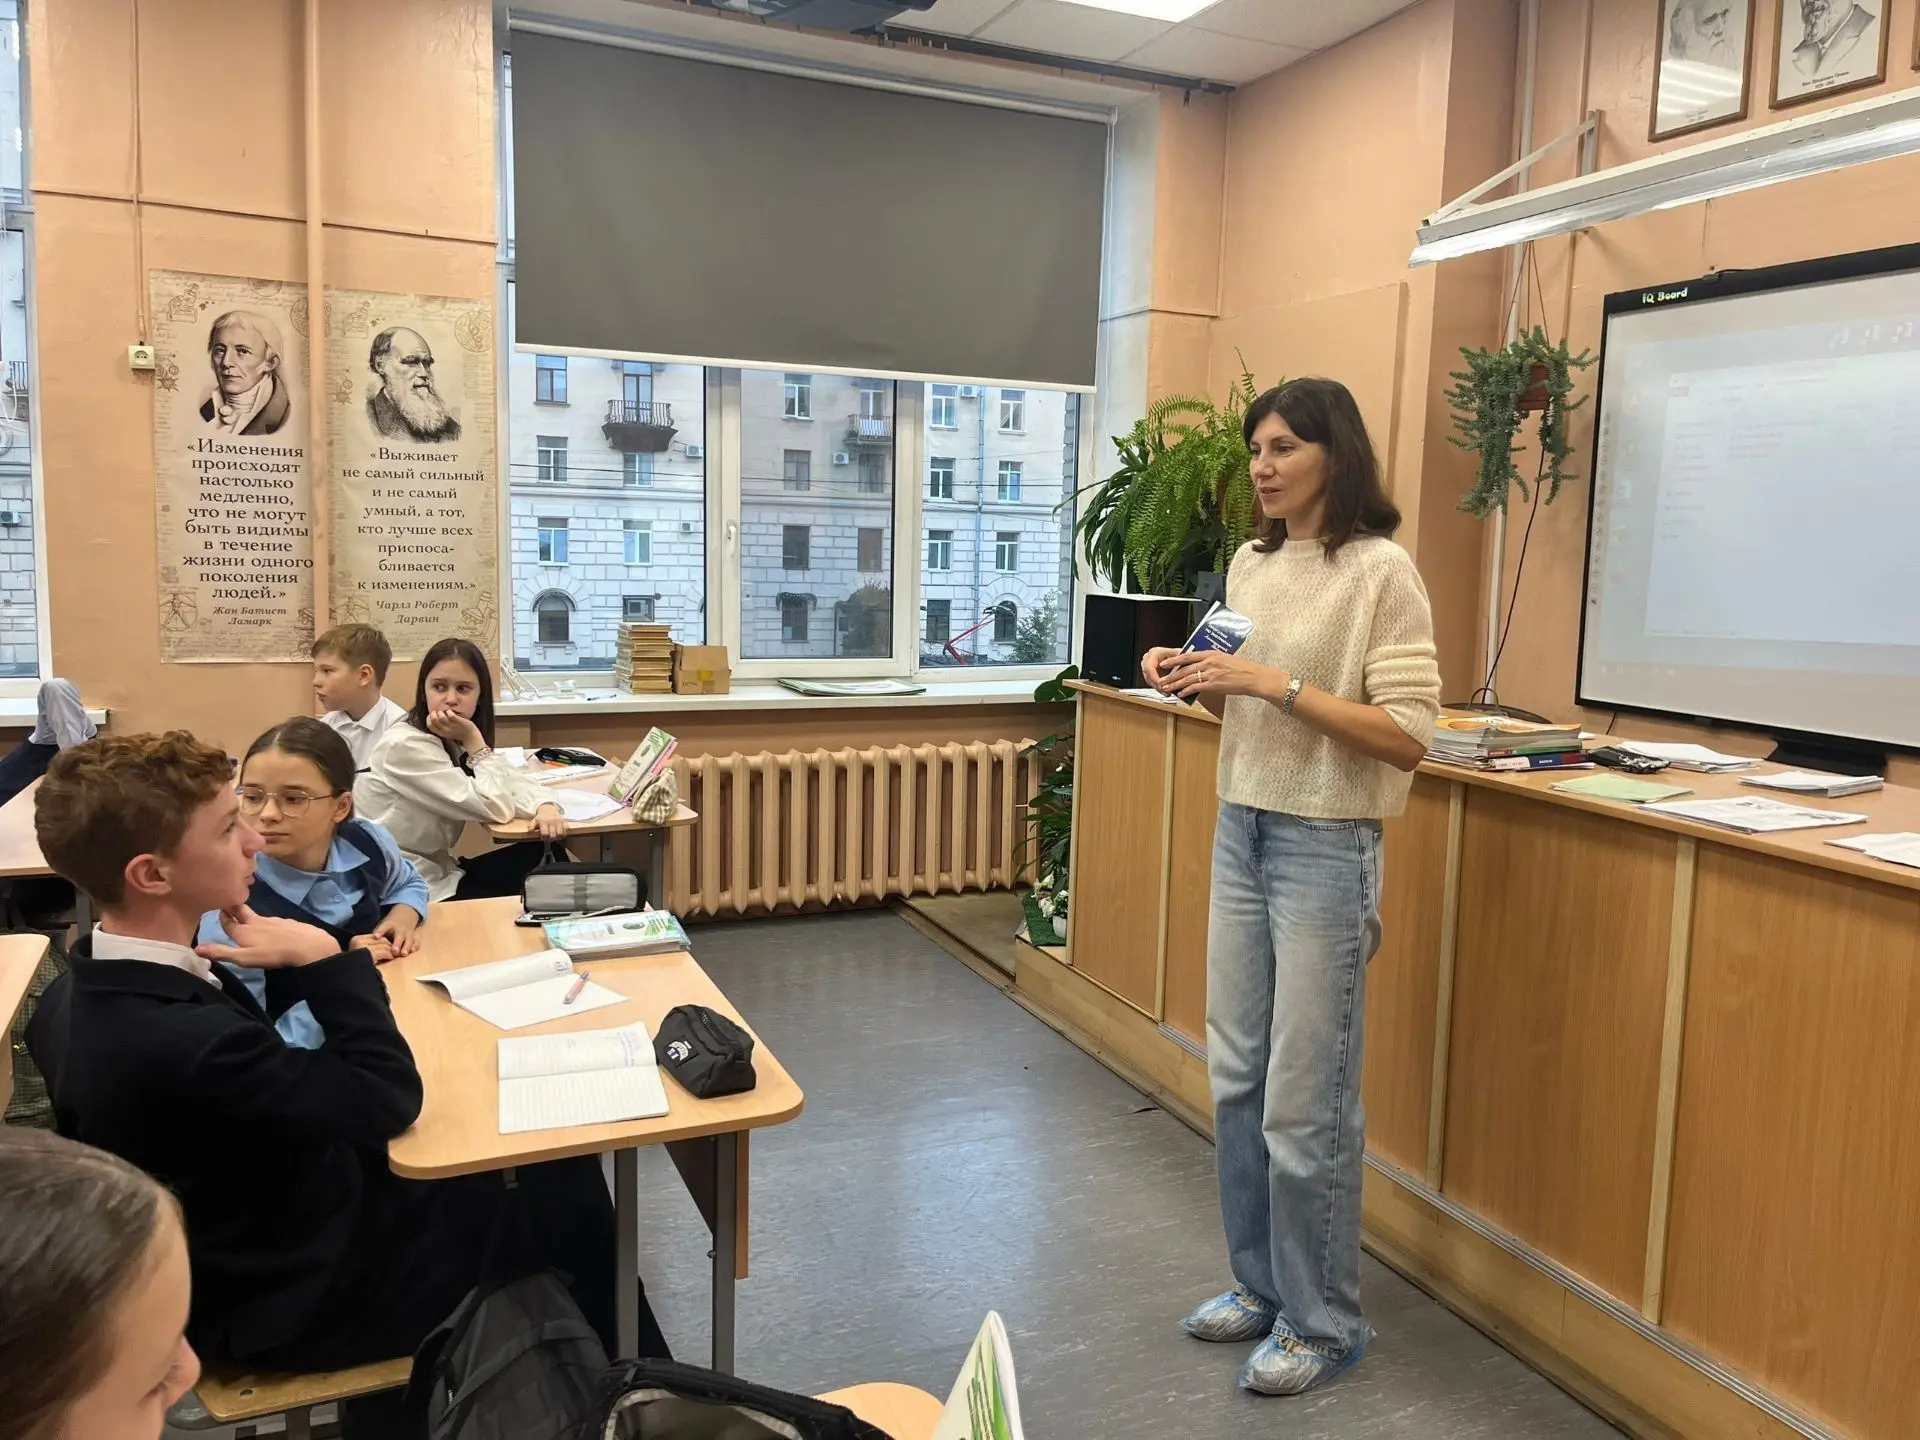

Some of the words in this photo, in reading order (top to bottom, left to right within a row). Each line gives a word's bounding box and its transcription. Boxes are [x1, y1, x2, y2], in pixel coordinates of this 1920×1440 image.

[1657, 287, 1688, 301] Board
[187, 438, 304, 458] «Изменения
[370, 447, 459, 462] «Выживает
[191, 459, 301, 474] происходят
[342, 468, 361, 478] не
[365, 468, 415, 479] самый
[419, 470, 485, 482] сильный
[199, 476, 294, 489] настолько
[199, 492, 294, 506] медленно,
[372, 488, 382, 497] и
[387, 489, 405, 498] не
[408, 488, 457, 499] самый
[188, 508, 220, 518] что
[226, 509, 247, 519] не
[253, 510, 307, 525] могут
[363, 505, 421, 519] умный,
[425, 508, 434, 517] а
[438, 508, 466, 519] тот,
[185, 519, 231, 535] быть
[237, 525, 309, 537] видимы
[357, 525, 384, 535] кто
[387, 526, 437, 539] лучше
[441, 526, 474, 536] всех
[204, 541, 214, 550] в
[219, 541, 293, 552] течение
[378, 544, 456, 557] приспоса-
[182, 556, 245, 567] жизни
[251, 557, 314, 569] одного
[379, 559, 456, 572] бливается
[199, 572, 299, 584] поколения
[357, 582, 367, 590] к
[371, 581, 477, 591] изменениям.»
[212, 586, 287, 600] людей.»
[212, 606, 238, 616] Жан
[240, 606, 287, 616] Батист
[376, 600, 412, 612] Чарлз
[414, 600, 459, 612] Роберт
[228, 617, 272, 627] Ламарк
[394, 614, 440, 625] Дарвин
